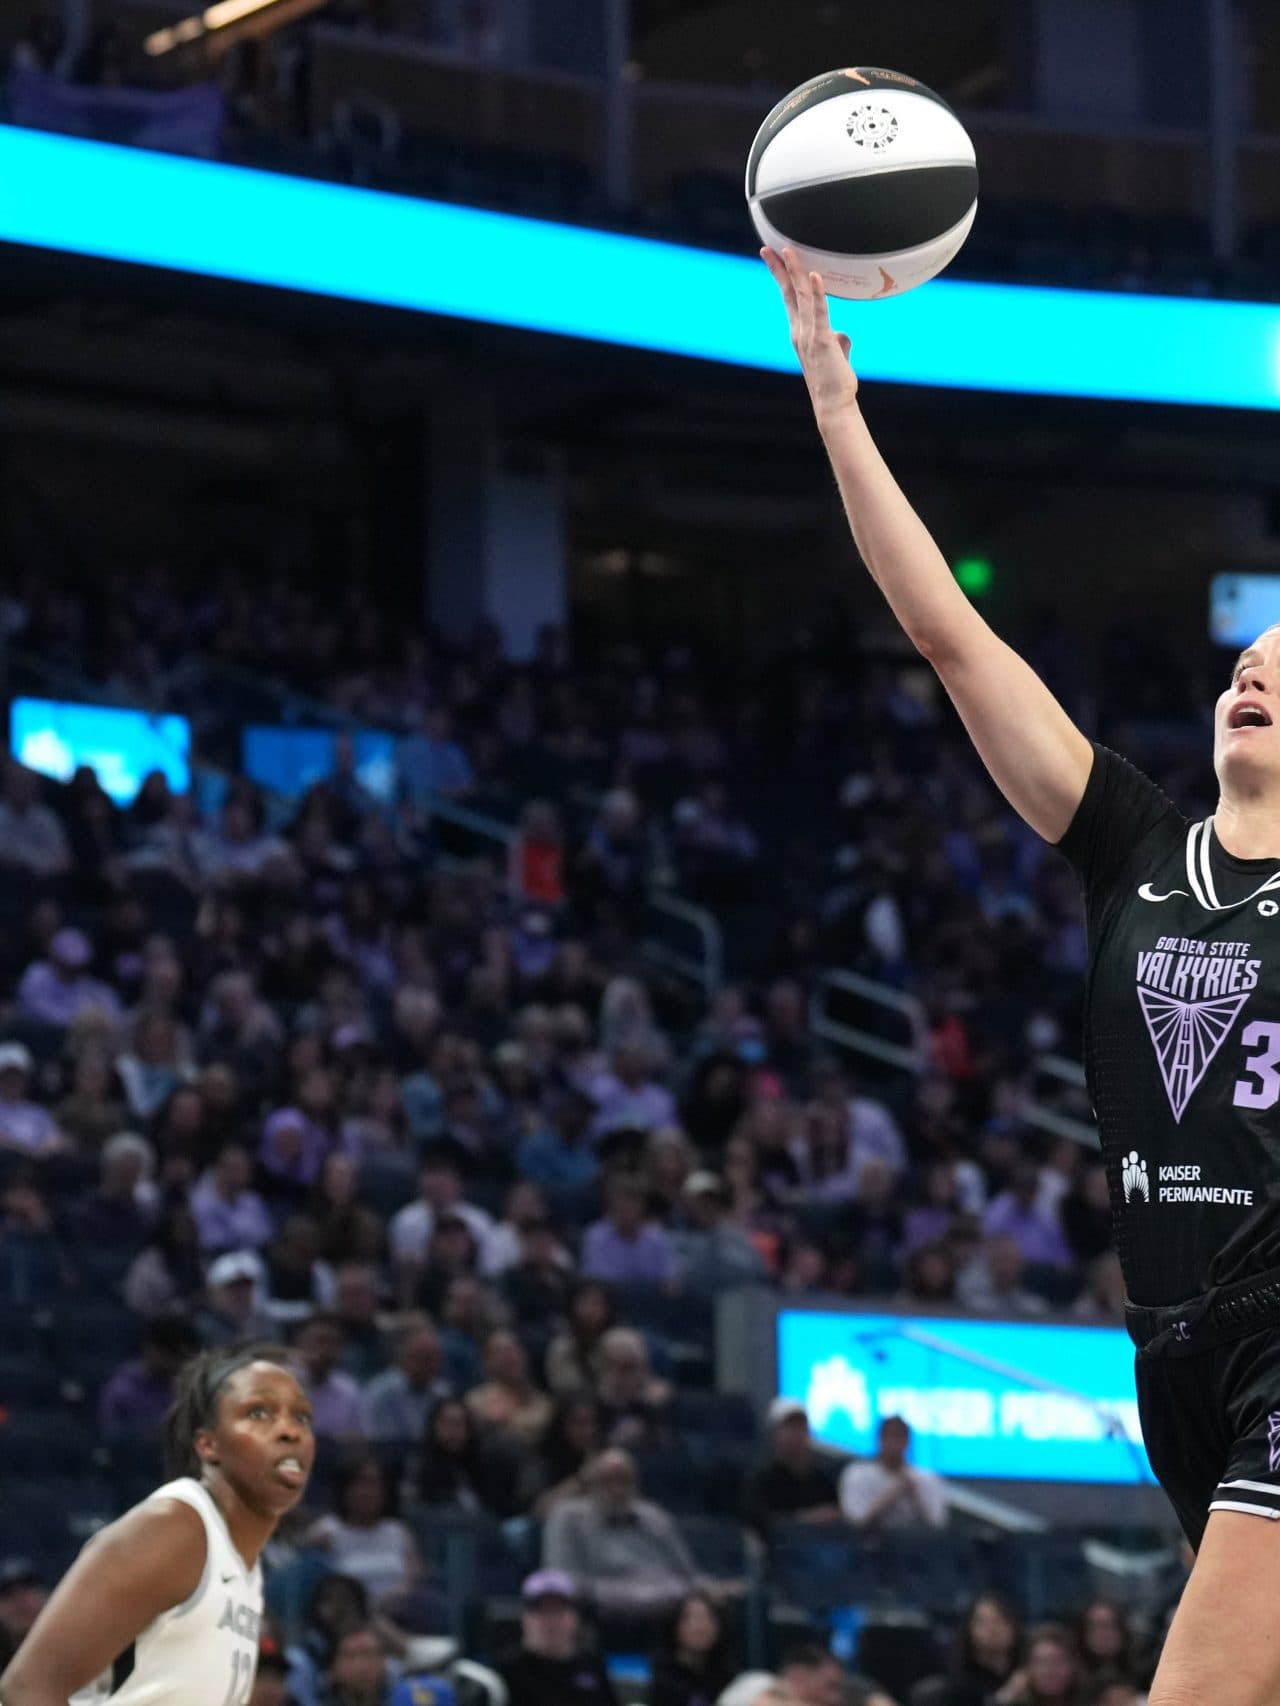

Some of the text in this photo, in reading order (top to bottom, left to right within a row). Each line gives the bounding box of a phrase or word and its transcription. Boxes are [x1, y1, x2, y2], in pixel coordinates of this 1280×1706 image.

[1155, 936, 1251, 957] GOLDEN STATE
[1136, 951, 1262, 1001] VALKYRIES
[1159, 1165, 1201, 1181] KAISER
[1159, 1186, 1254, 1206] PERMANENTE
